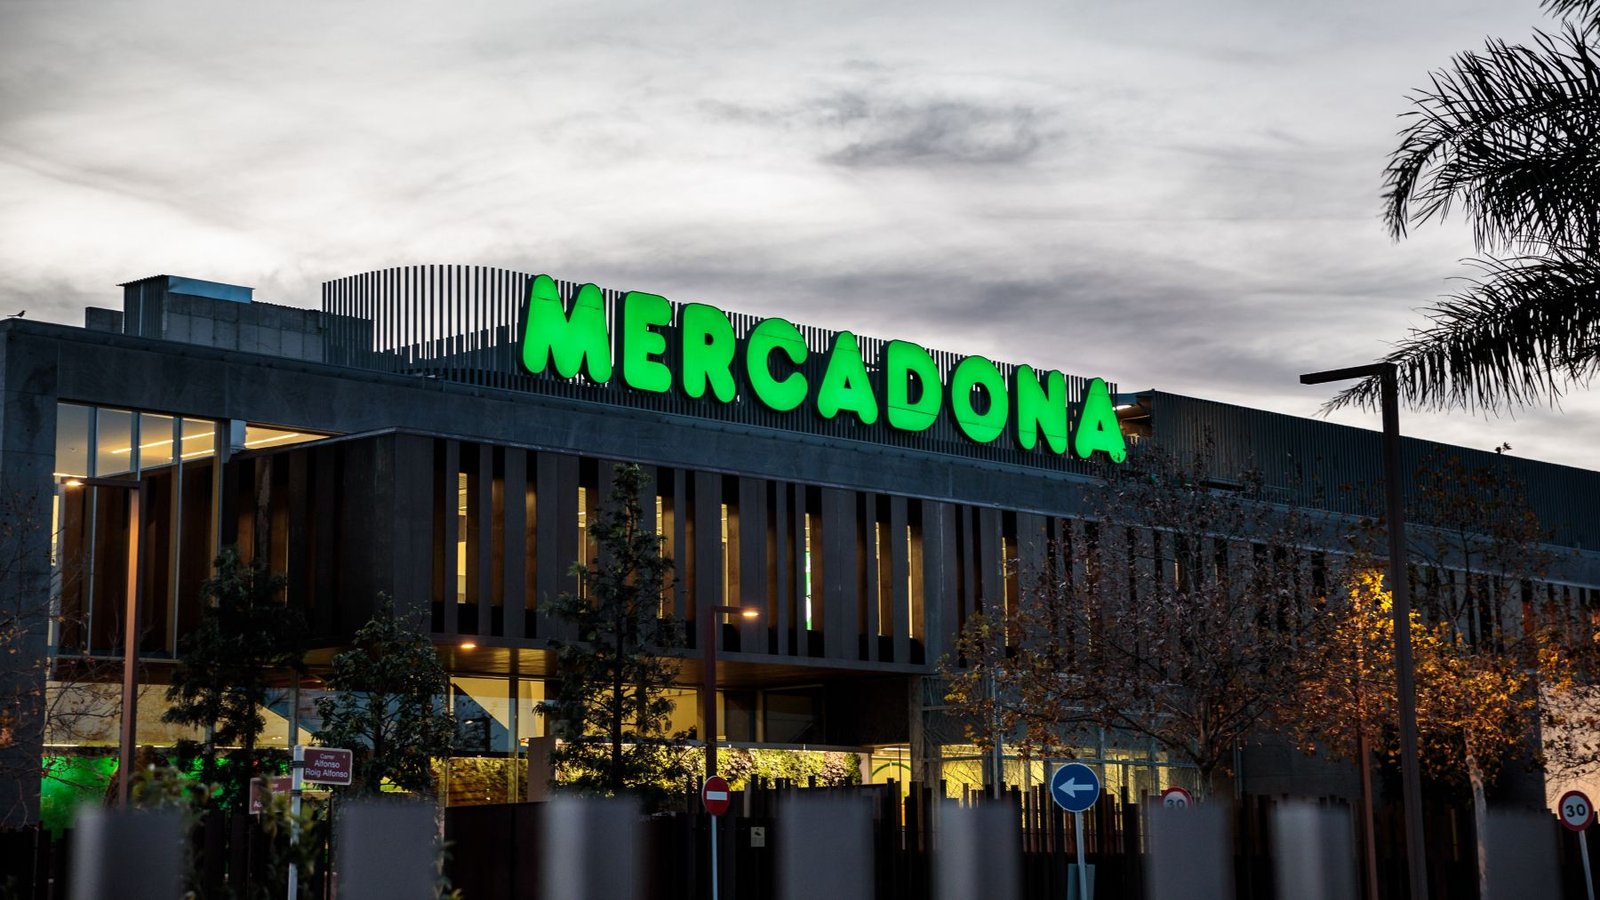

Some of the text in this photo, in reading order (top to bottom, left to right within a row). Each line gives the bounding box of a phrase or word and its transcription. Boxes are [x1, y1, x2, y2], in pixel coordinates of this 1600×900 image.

[522, 273, 1128, 465] MERCADONA
[314, 760, 341, 769] Alfonso
[305, 768, 349, 778] Roig Alfonso
[1167, 799, 1185, 809] 30
[1565, 803, 1586, 818] 30
